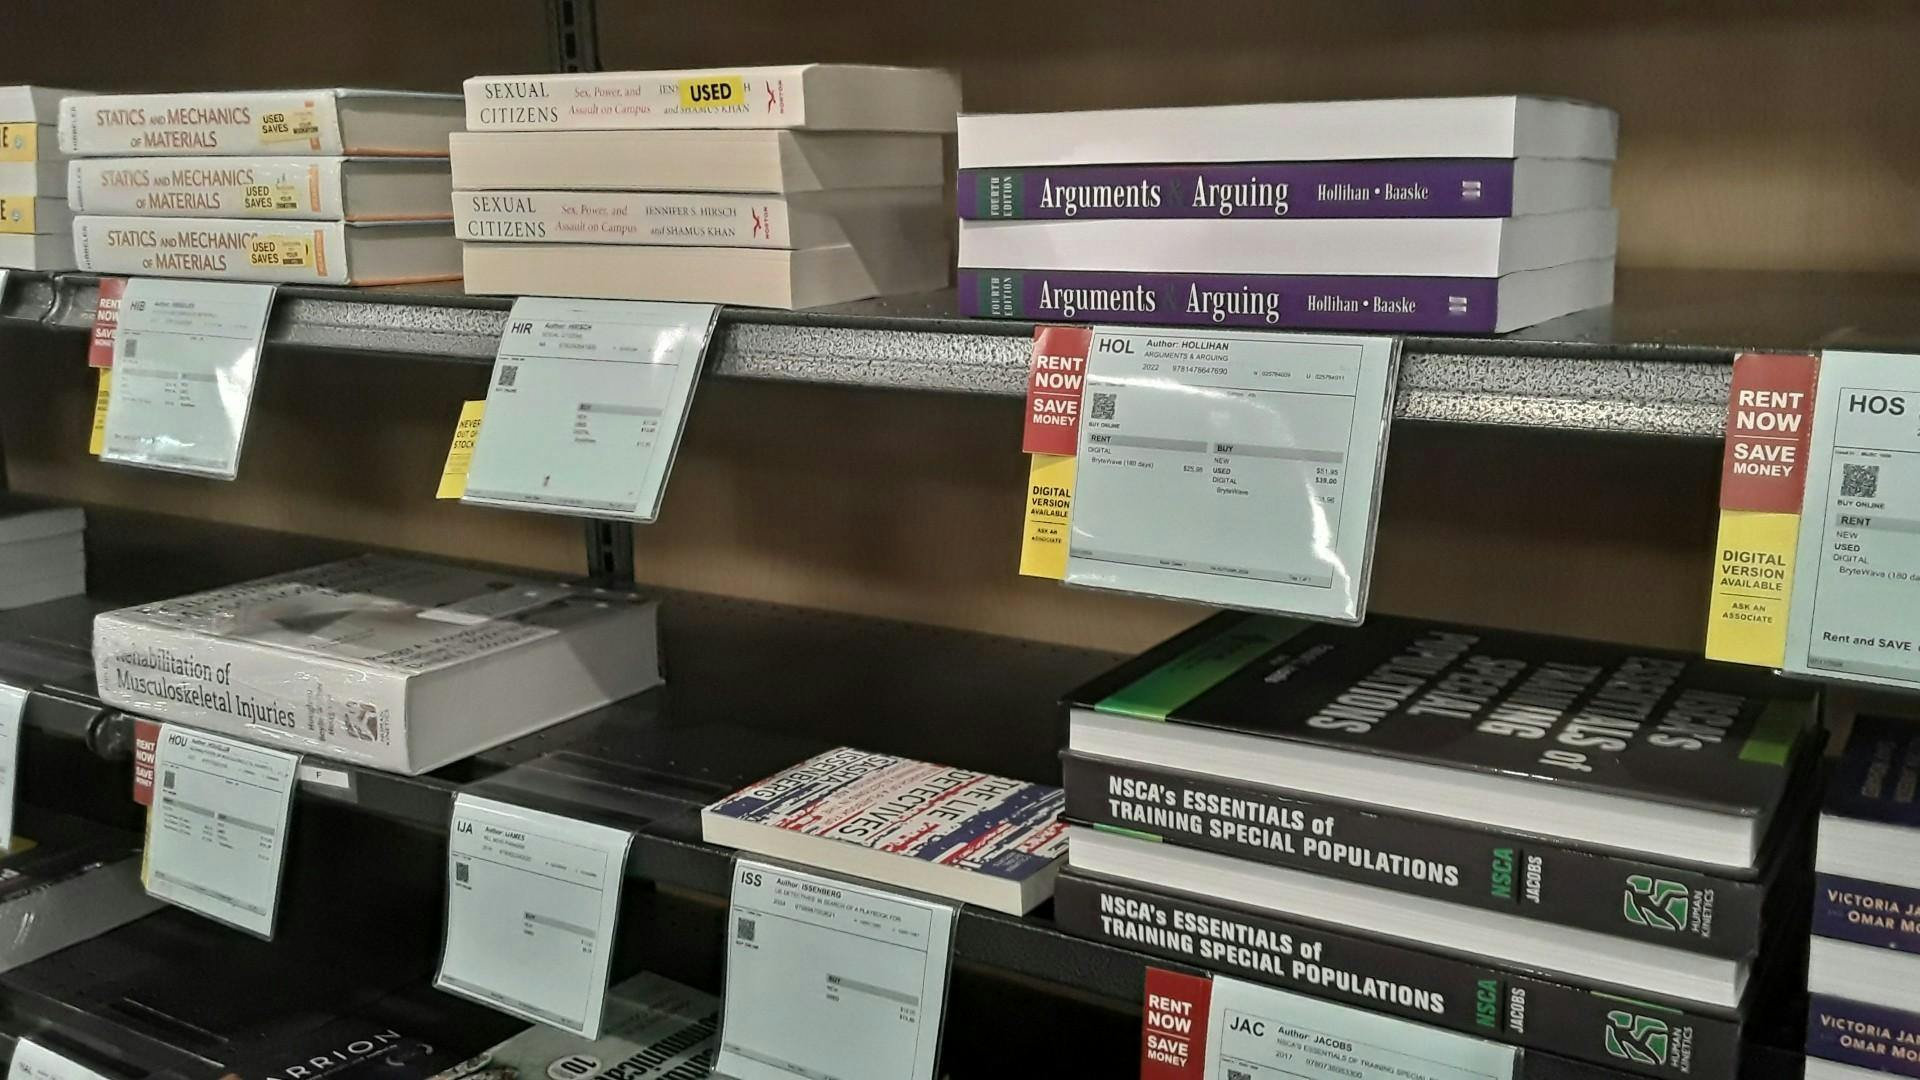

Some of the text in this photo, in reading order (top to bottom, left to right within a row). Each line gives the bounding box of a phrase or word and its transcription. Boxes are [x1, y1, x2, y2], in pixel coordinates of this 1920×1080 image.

[485, 83, 550, 99] SEXUAL
[623, 86, 641, 96] and
[690, 83, 732, 101] USED
[97, 109, 145, 126] STATICS
[167, 107, 250, 126] MECHANICS
[480, 107, 559, 123] CITIZENS
[570, 104, 650, 117] Assault Campus
[722, 104, 750, 114] KHAN
[263, 114, 285, 123] USED
[262, 124, 289, 134] SAVES
[144, 131, 218, 148] MATERIALS
[101, 170, 149, 186] STATICS
[171, 169, 254, 187] MECHANICS
[246, 186, 269, 196] USED
[1040, 175, 1289, 217] Arguments Arguing
[1318, 183, 1429, 201] Hollihan Baaske
[149, 193, 220, 209] MATERIALS
[245, 197, 272, 208] SAVES
[472, 197, 537, 213] SEXUAL
[609, 205, 628, 216] and
[646, 207, 737, 217] JENNIFER HIRSCH
[468, 221, 546, 238] CITIZENS
[556, 221, 637, 234] Assault on Campus
[665, 226, 737, 237] SHAMUS KHAN
[108, 231, 157, 248] STATICS
[178, 231, 258, 250] MECHANIC
[252, 242, 276, 252] USED
[156, 253, 227, 271] MATERIALS
[251, 253, 279, 264] SAVES
[130, 301, 145, 310] HIB
[1040, 279, 1280, 323] Arguments Arguing
[1307, 295, 1416, 314] Hollihan Baaske
[511, 322, 532, 334] HIR
[1099, 338, 1135, 354] HOL
[1146, 339, 1229, 351] Author: HOLLIHAN
[1037, 355, 1083, 371] RENT
[1144, 351, 1229, 362] ARGUMENTS ARGUING
[1142, 363, 1160, 371] 2022
[1035, 373, 1082, 390] NOW
[1033, 399, 1078, 414] SAVE
[1739, 390, 1804, 409] RENT
[1849, 394, 1906, 416] HOS
[1033, 414, 1076, 427] MONEY
[1736, 411, 1802, 433] NOW
[1091, 435, 1112, 443] RENT
[1088, 447, 1112, 455] DIGITAL
[1217, 444, 1234, 453] BUY
[1734, 443, 1797, 463] SAVE
[1214, 457, 1230, 465] NEW
[1213, 467, 1231, 475] USED
[1734, 463, 1793, 478] MONEY
[1212, 477, 1237, 485] DIGITAL
[1033, 486, 1071, 498] DIGITAL
[1032, 498, 1070, 509] VERSION
[1837, 499, 1885, 510] BUY ONLINE
[1031, 508, 1068, 518] AVAILABLE
[1841, 516, 1872, 527] RENT
[1836, 530, 1858, 539] NEW
[1834, 542, 1861, 552] USED
[1722, 550, 1787, 567] DIGITAL
[1833, 553, 1869, 565] DIGITAL
[1721, 565, 1785, 580] VERSION
[1839, 566, 1885, 578] BryteWave
[1720, 578, 1783, 591] AVAILABLE
[1732, 602, 1766, 612] ASK AN
[1722, 612, 1773, 624] ASSOCIATE
[1823, 631, 1912, 652] Rent and SAVE
[216, 662, 231, 686] of
[116, 668, 232, 714] Musculoskeletal
[236, 695, 296, 729] Injuries
[168, 734, 187, 747] HOU
[754, 749, 862, 799] ISSENBERG
[820, 753, 890, 786] SASHA
[967, 778, 1020, 802] THE
[839, 770, 974, 837] DETECTIVES
[1109, 775, 1335, 837] NSCA's ESSENTIALS of
[457, 820, 473, 834] IJA
[1109, 799, 1460, 887] TRAINING SPECIAL POPULATIONS
[741, 871, 762, 887] ISS
[1491, 848, 1513, 898] NSCA
[1526, 855, 1542, 904] JACOBS
[801, 883, 842, 899] ISSENBERG
[1827, 889, 1899, 913] VICTORIA
[1691, 890, 1703, 933] HUMAN
[1701, 888, 1714, 938] KINETICS
[1100, 893, 1323, 961] NSCA's ESSENTIALS of
[1848, 910, 1895, 931] OMAR
[1100, 916, 1446, 1014] TRAINING SPECIAL POPULATIONS
[1148, 994, 1192, 1017] RENT
[1476, 980, 1497, 1028] NSCA
[1510, 987, 1526, 1034] JACOBS
[1147, 1010, 1191, 1034] NOW
[1230, 1016, 1265, 1037] JAC
[1820, 1014, 1891, 1041] VICTORIA
[1147, 1035, 1189, 1057] SAVE
[1313, 1035, 1353, 1052] JACOBS
[1671, 1027, 1683, 1068] HUMAN
[1681, 1026, 1692, 1073] KINETICS
[1840, 1034, 1887, 1055] OMAR
[266, 1029, 401, 1080] RRION
[1147, 1049, 1188, 1068] MONEY
[1275, 1050, 1293, 1060] 2017
[561, 1056, 597, 1075] 10
